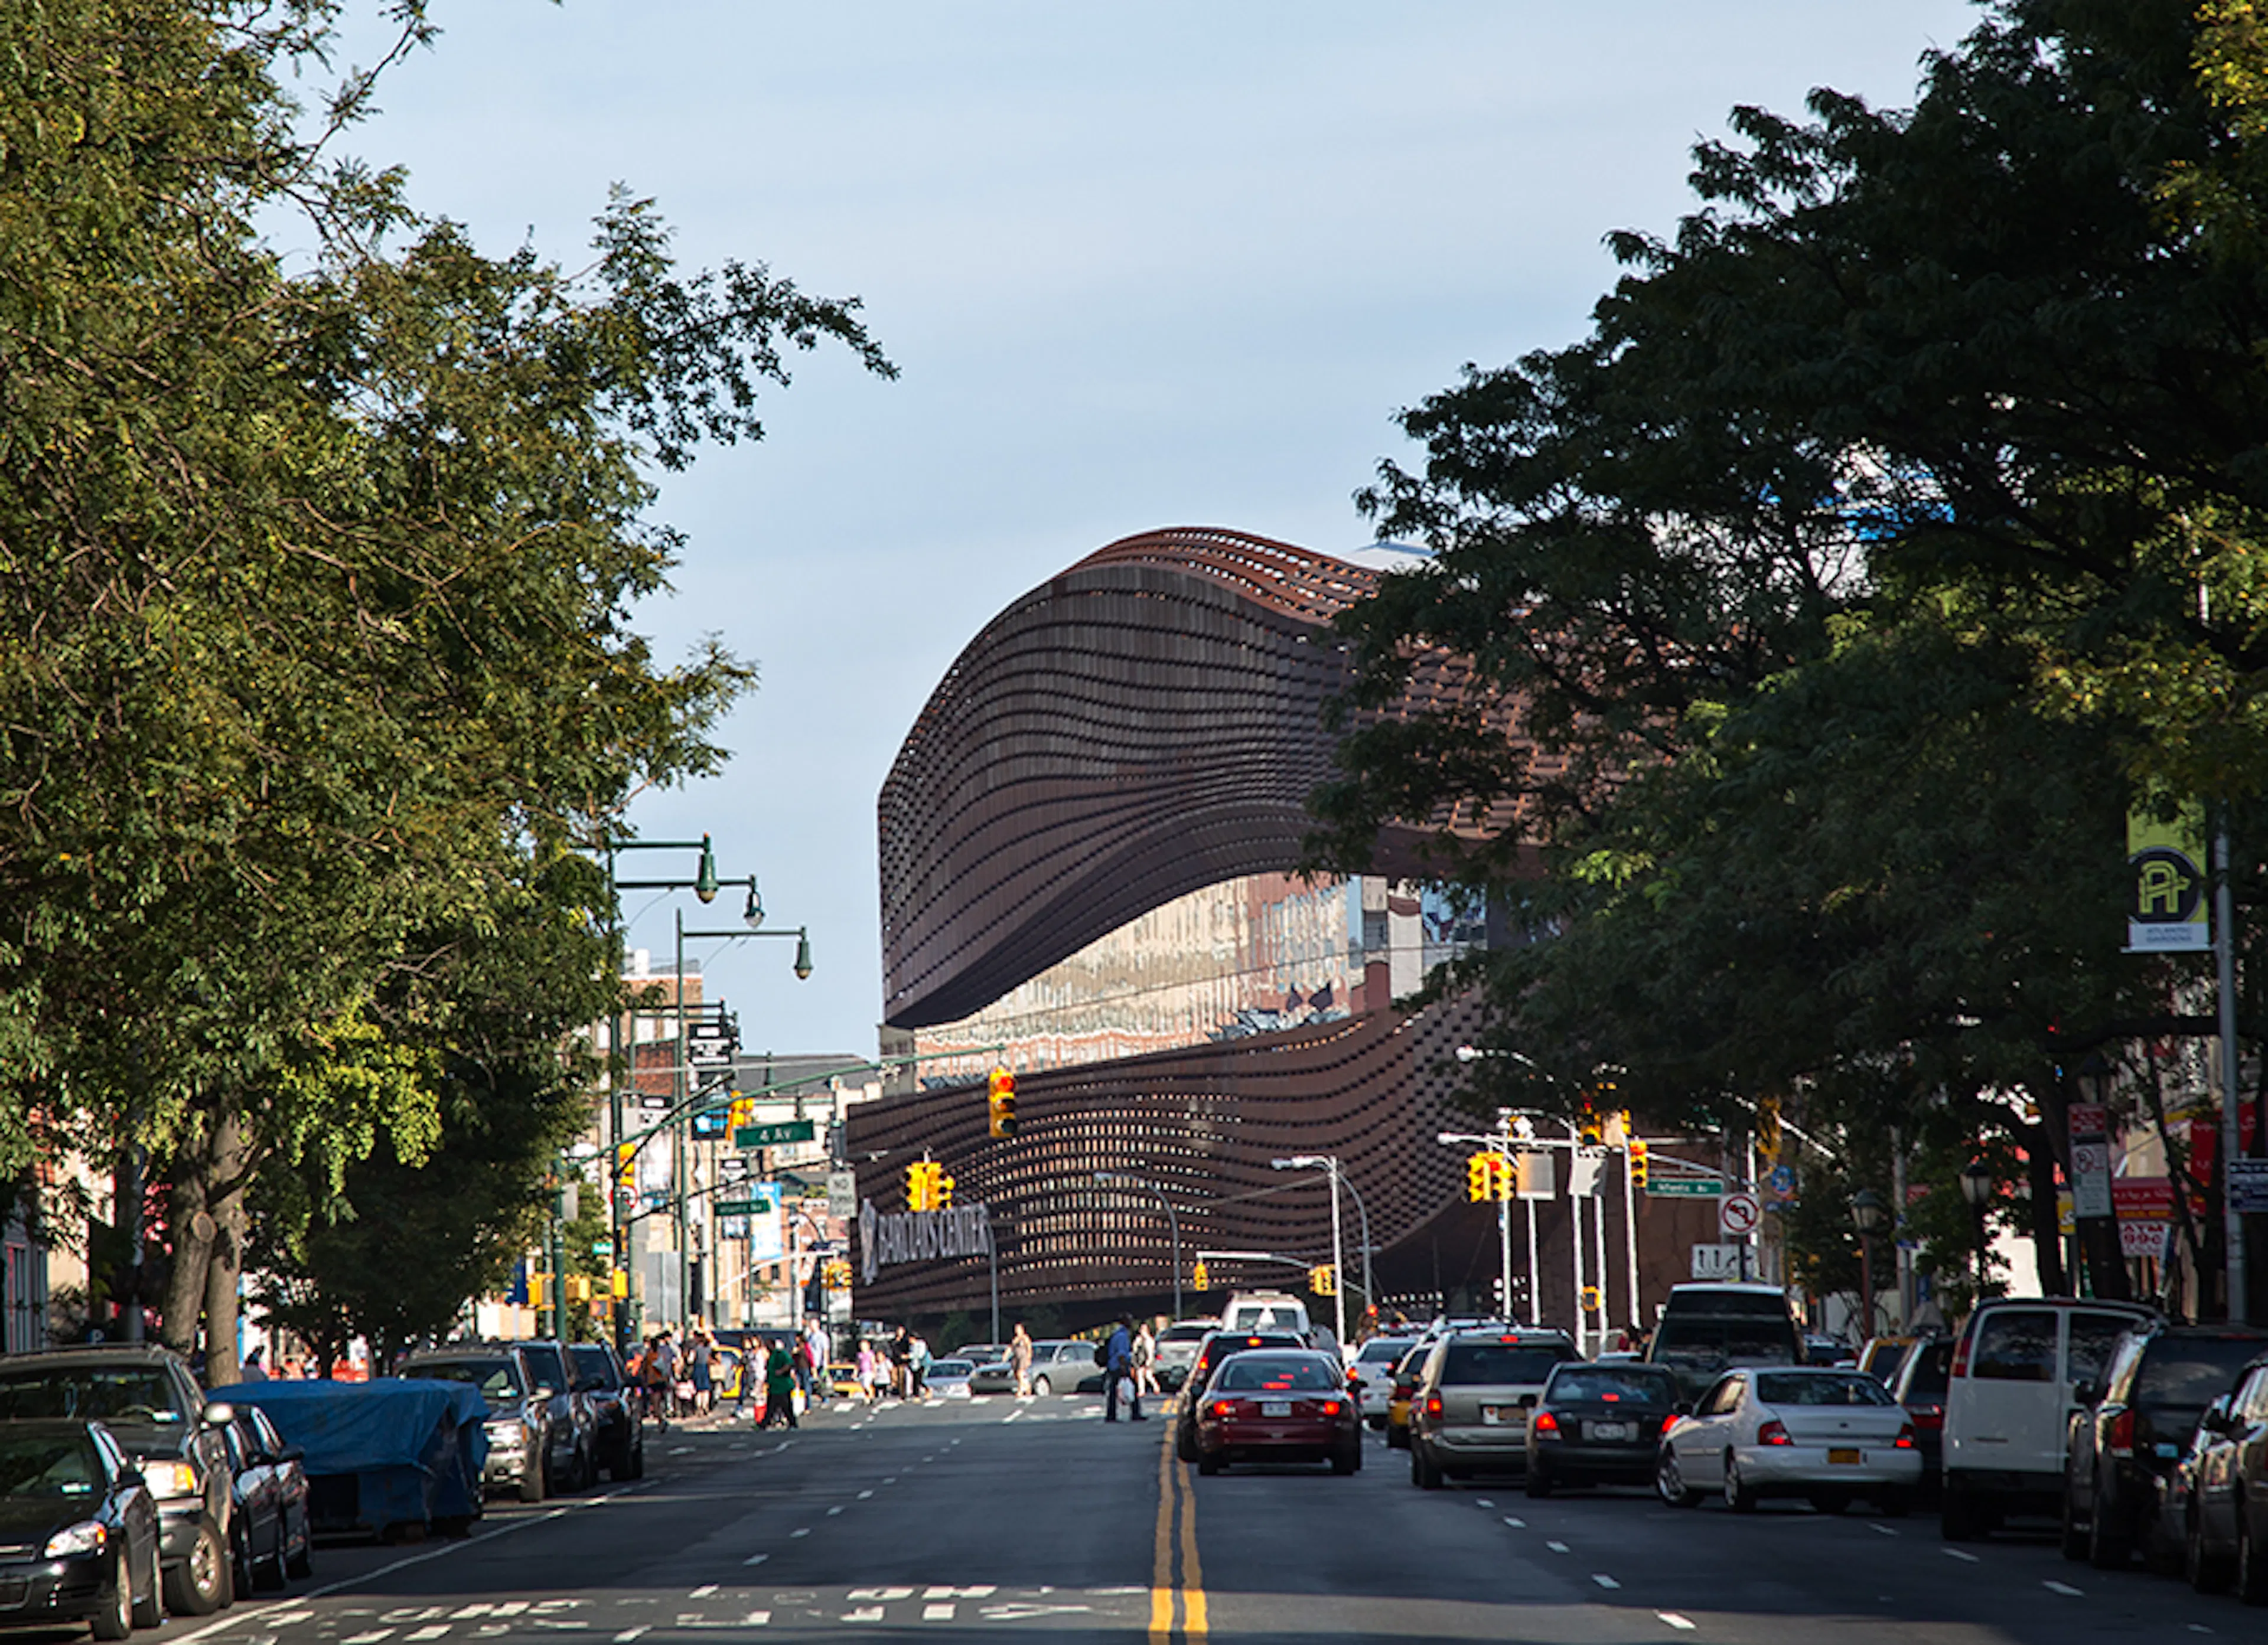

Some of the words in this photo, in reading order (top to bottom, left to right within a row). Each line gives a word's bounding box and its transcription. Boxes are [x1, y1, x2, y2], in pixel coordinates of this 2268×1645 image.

[760, 1129, 770, 1143] 4
[878, 1211, 937, 1264] BARCLAYS
[939, 1202, 989, 1257] CENTER
